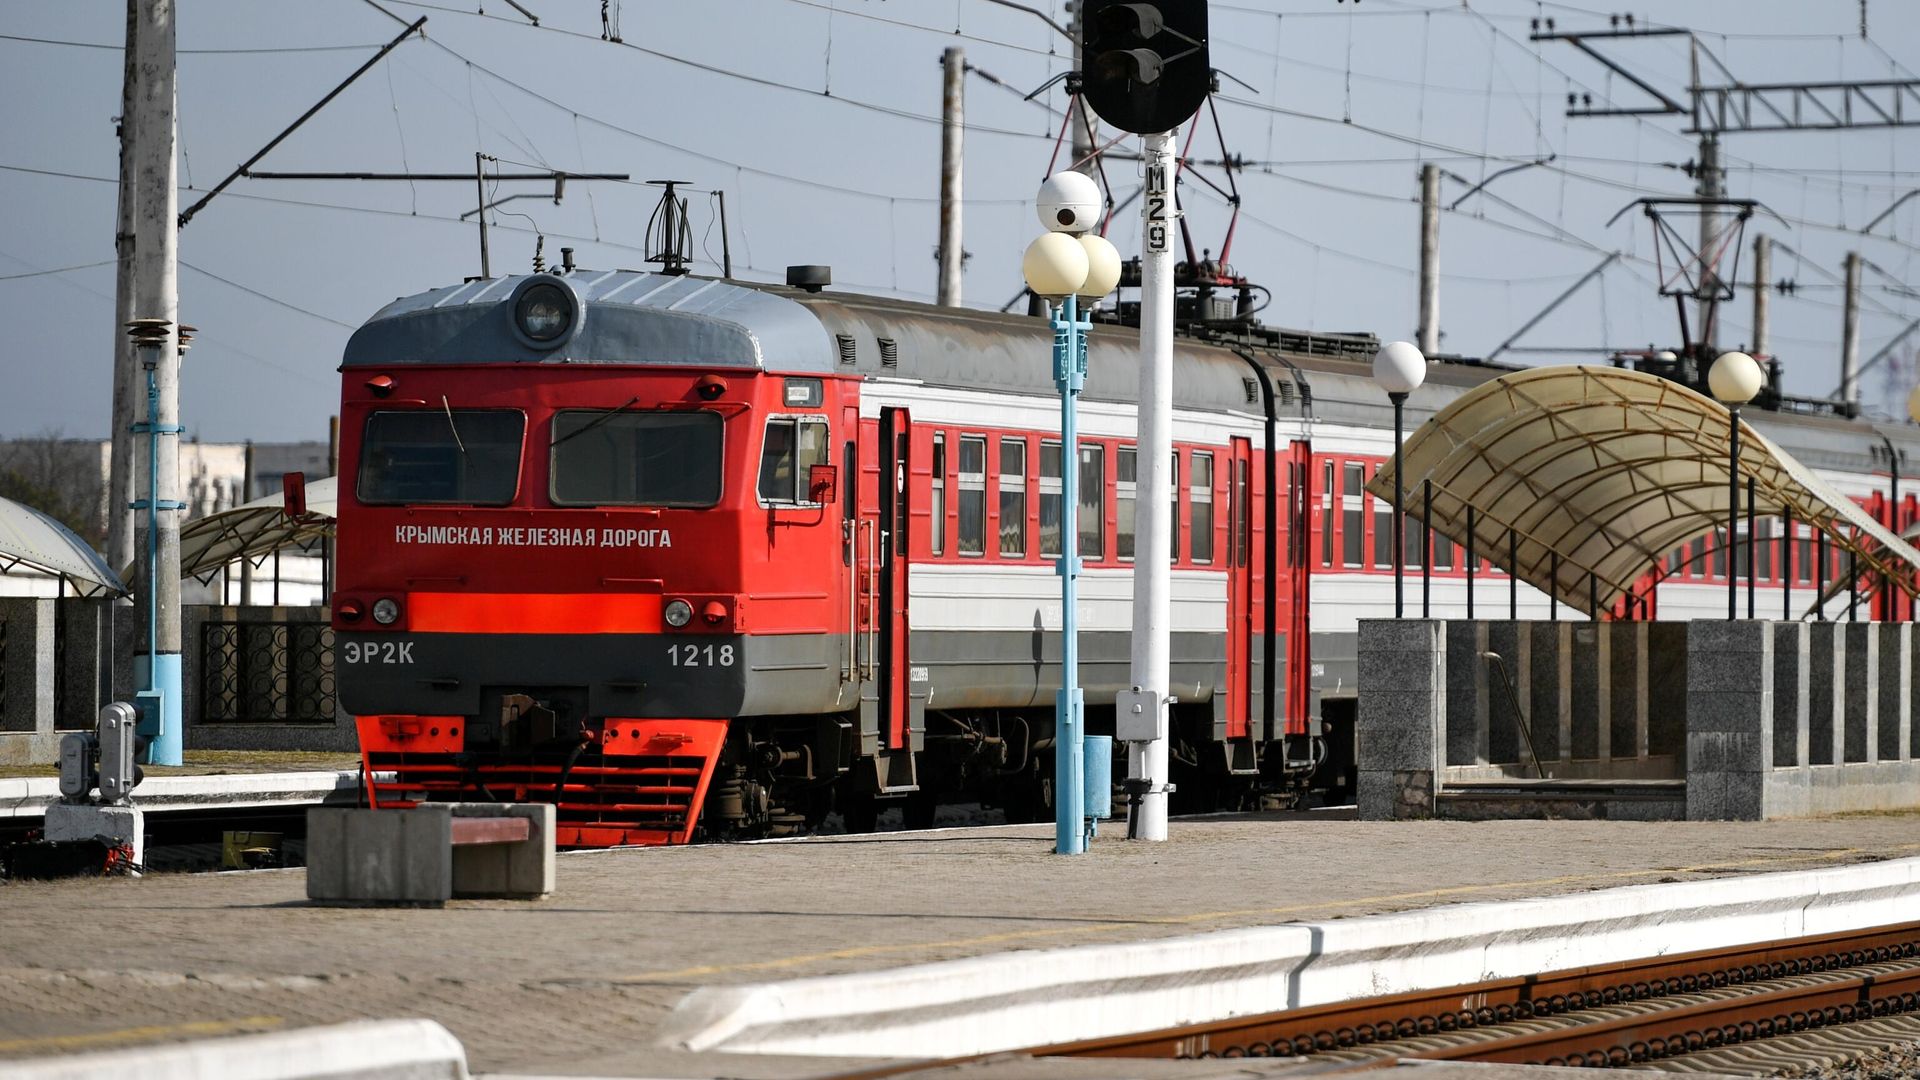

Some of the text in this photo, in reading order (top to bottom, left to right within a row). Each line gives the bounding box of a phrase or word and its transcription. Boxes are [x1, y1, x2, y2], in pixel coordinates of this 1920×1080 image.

[395, 525, 672, 548] КРЫМСКАЯ ЖЕЛЕЗНАЯ ДОРОГА
[344, 641, 415, 664] ЭР2К
[667, 644, 735, 667] 1218
